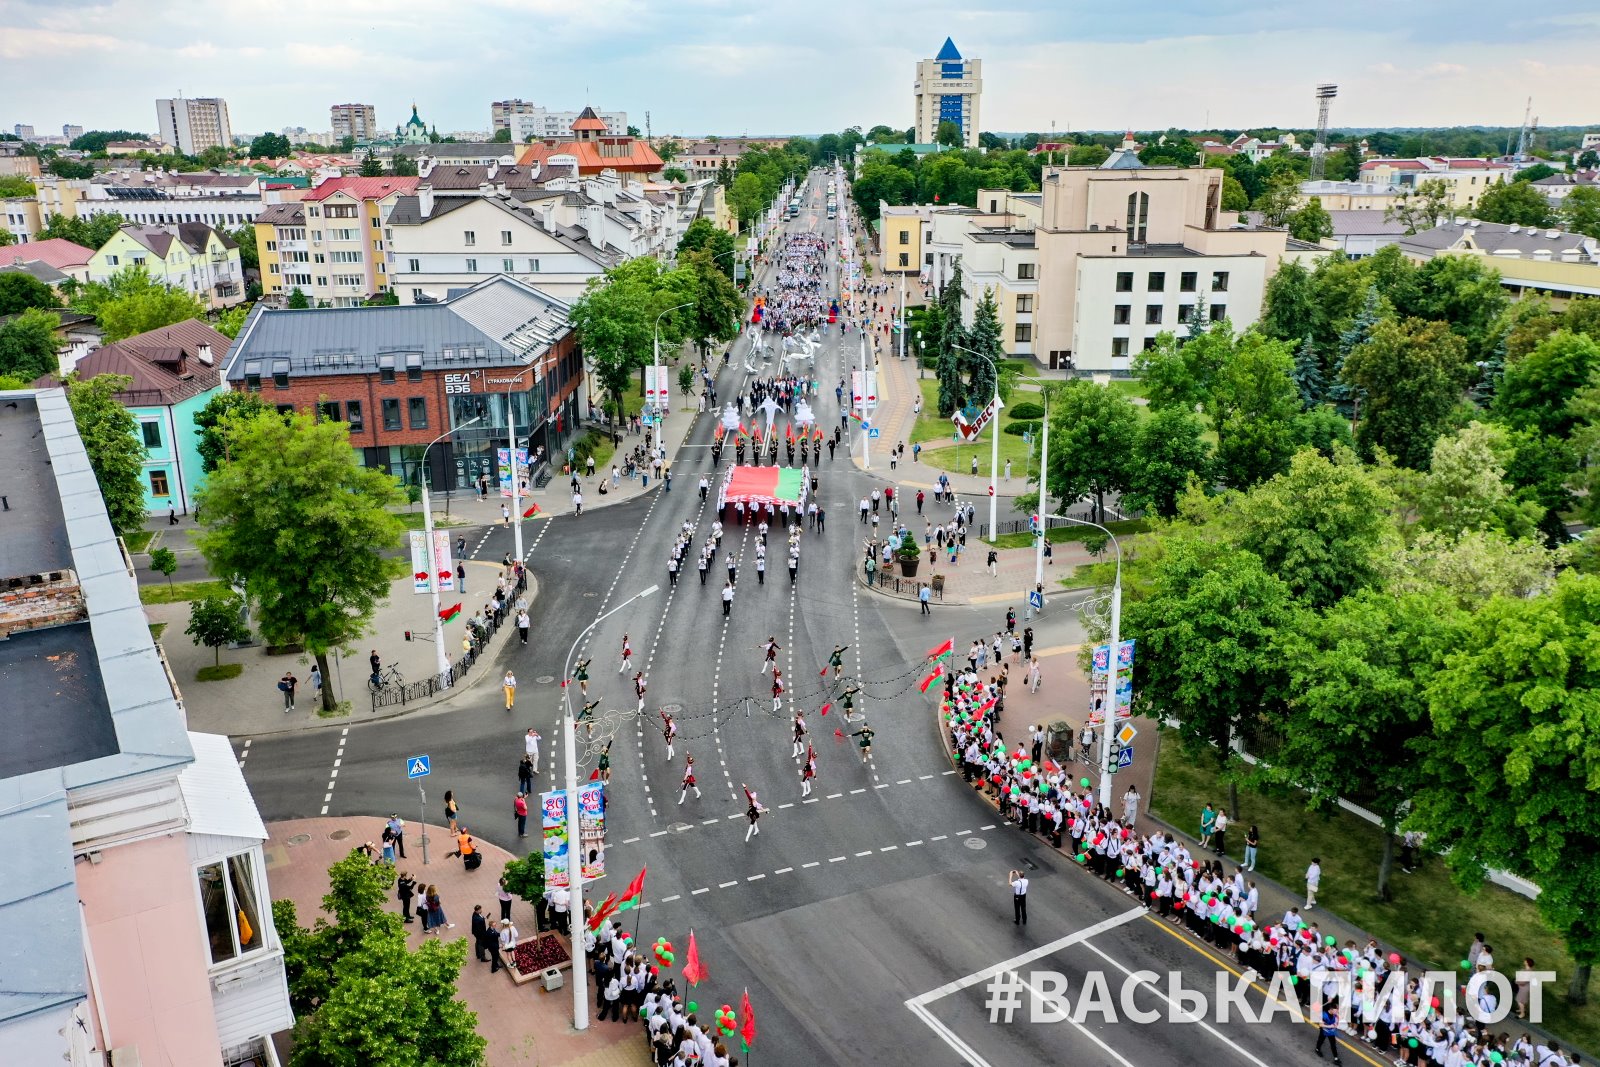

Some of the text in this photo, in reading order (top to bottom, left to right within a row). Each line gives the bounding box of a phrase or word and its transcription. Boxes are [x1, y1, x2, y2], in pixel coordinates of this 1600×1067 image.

[444, 373, 470, 383] БЕЛ
[445, 384, 471, 394] ВЭБ
[582, 789, 601, 804] 80
[545, 797, 566, 811] 80
